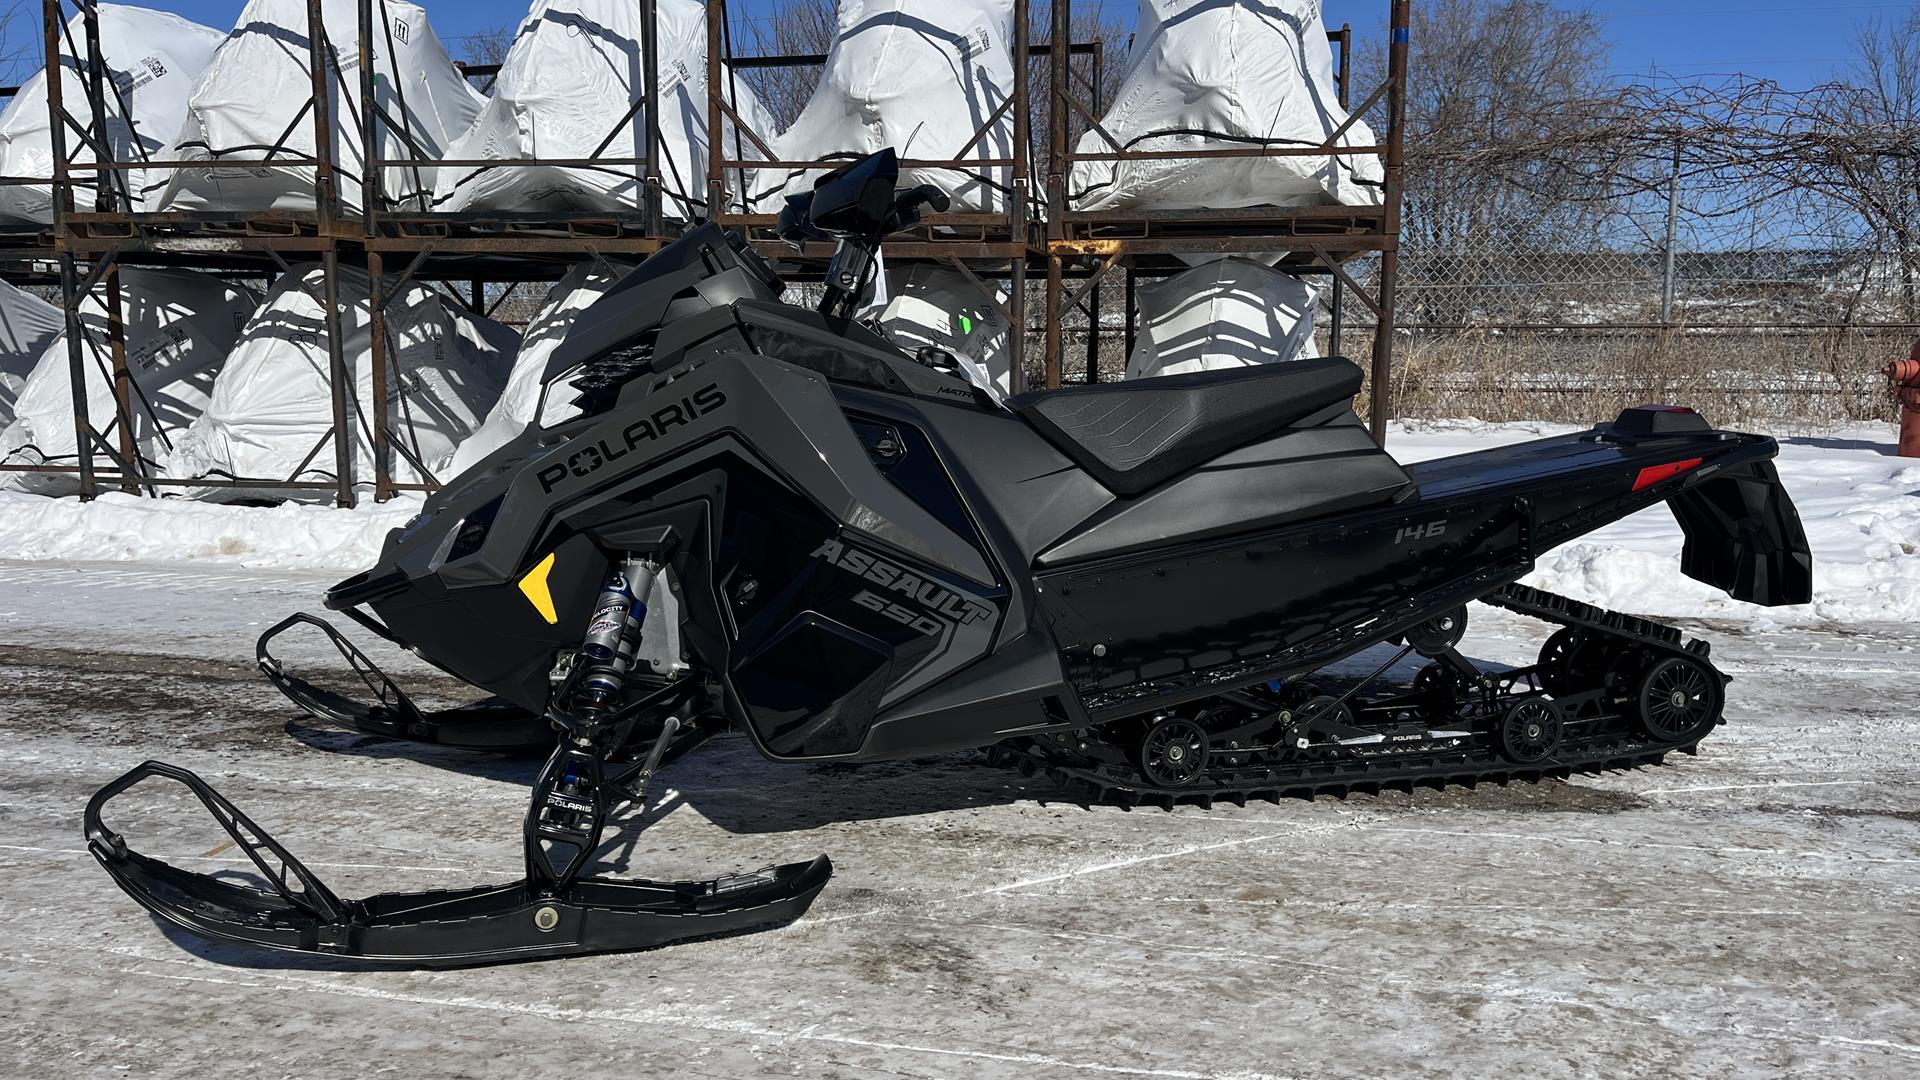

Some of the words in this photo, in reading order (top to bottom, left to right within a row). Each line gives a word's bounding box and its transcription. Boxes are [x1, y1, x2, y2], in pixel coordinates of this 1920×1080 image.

[536, 383, 727, 494] POLARIS
[1394, 520, 1447, 545] 146
[809, 538, 993, 625] ASSAULT
[851, 589, 942, 636] 650
[547, 798, 592, 812] POLARIS
